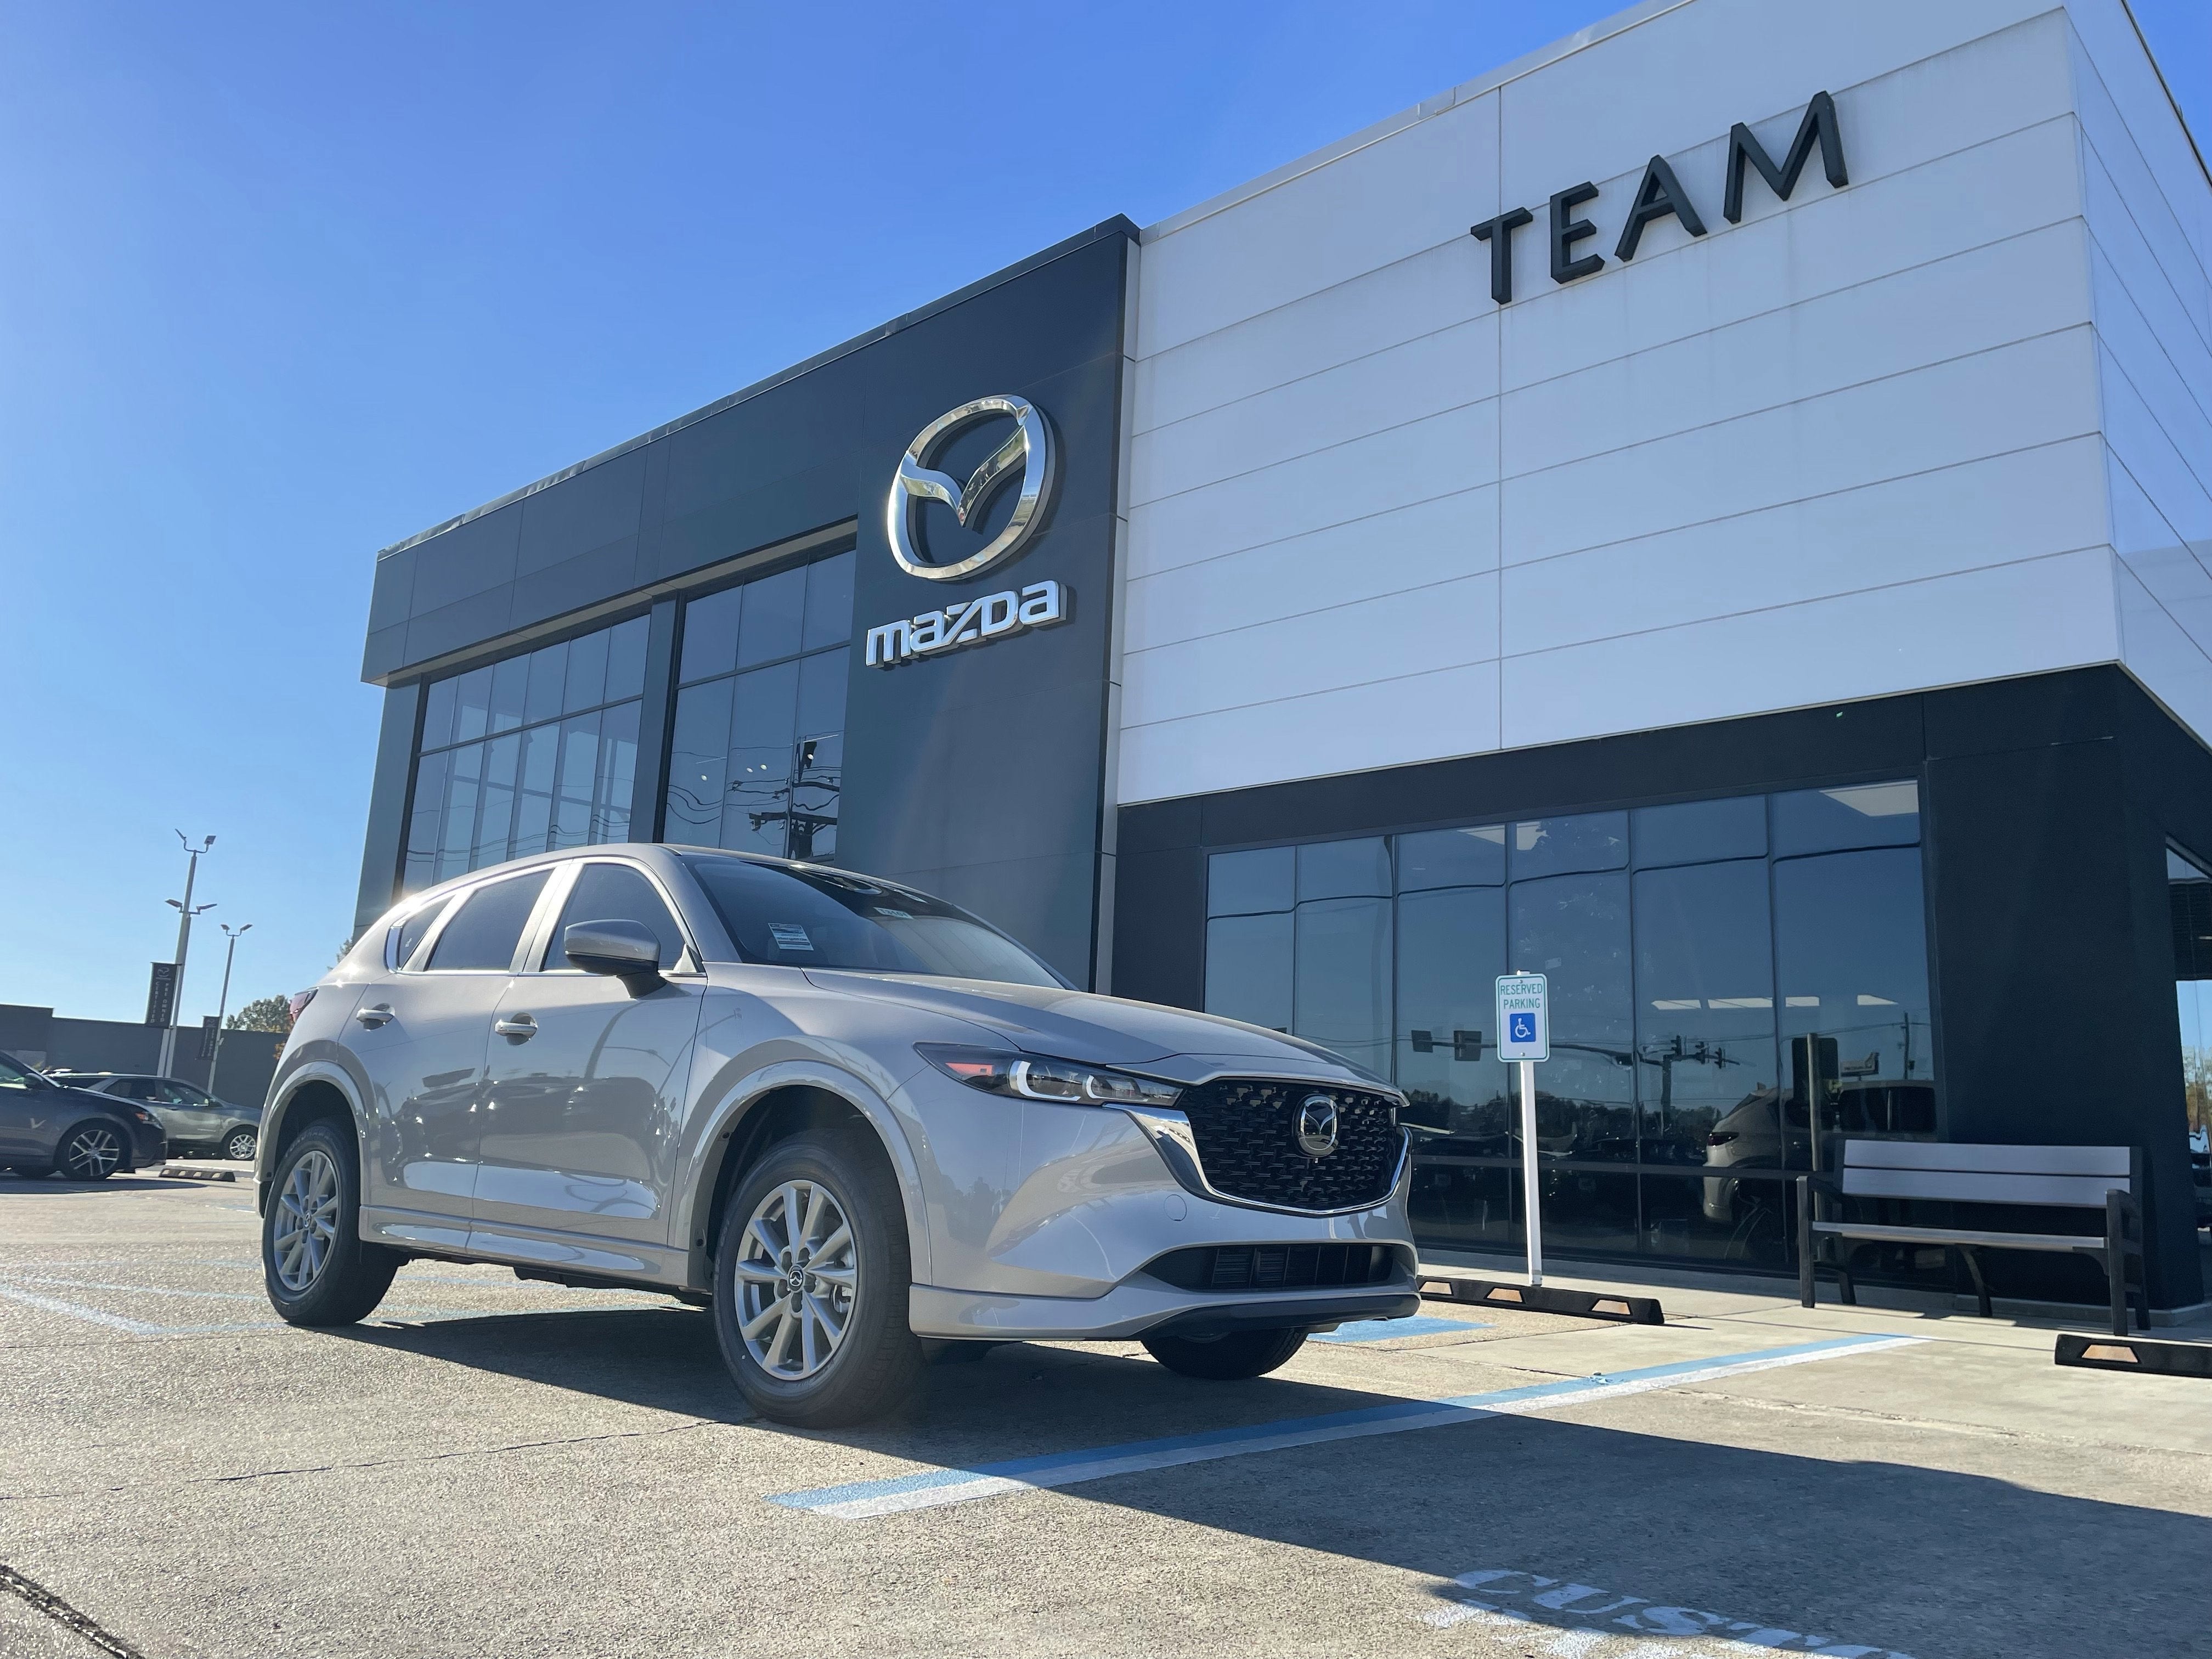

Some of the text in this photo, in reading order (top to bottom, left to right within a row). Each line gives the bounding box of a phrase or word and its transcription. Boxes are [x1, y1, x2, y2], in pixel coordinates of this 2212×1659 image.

[1471, 90, 1849, 305] TEAM
[1500, 984, 1543, 995] RESERVED
[1504, 998, 1541, 1010] PARKING
